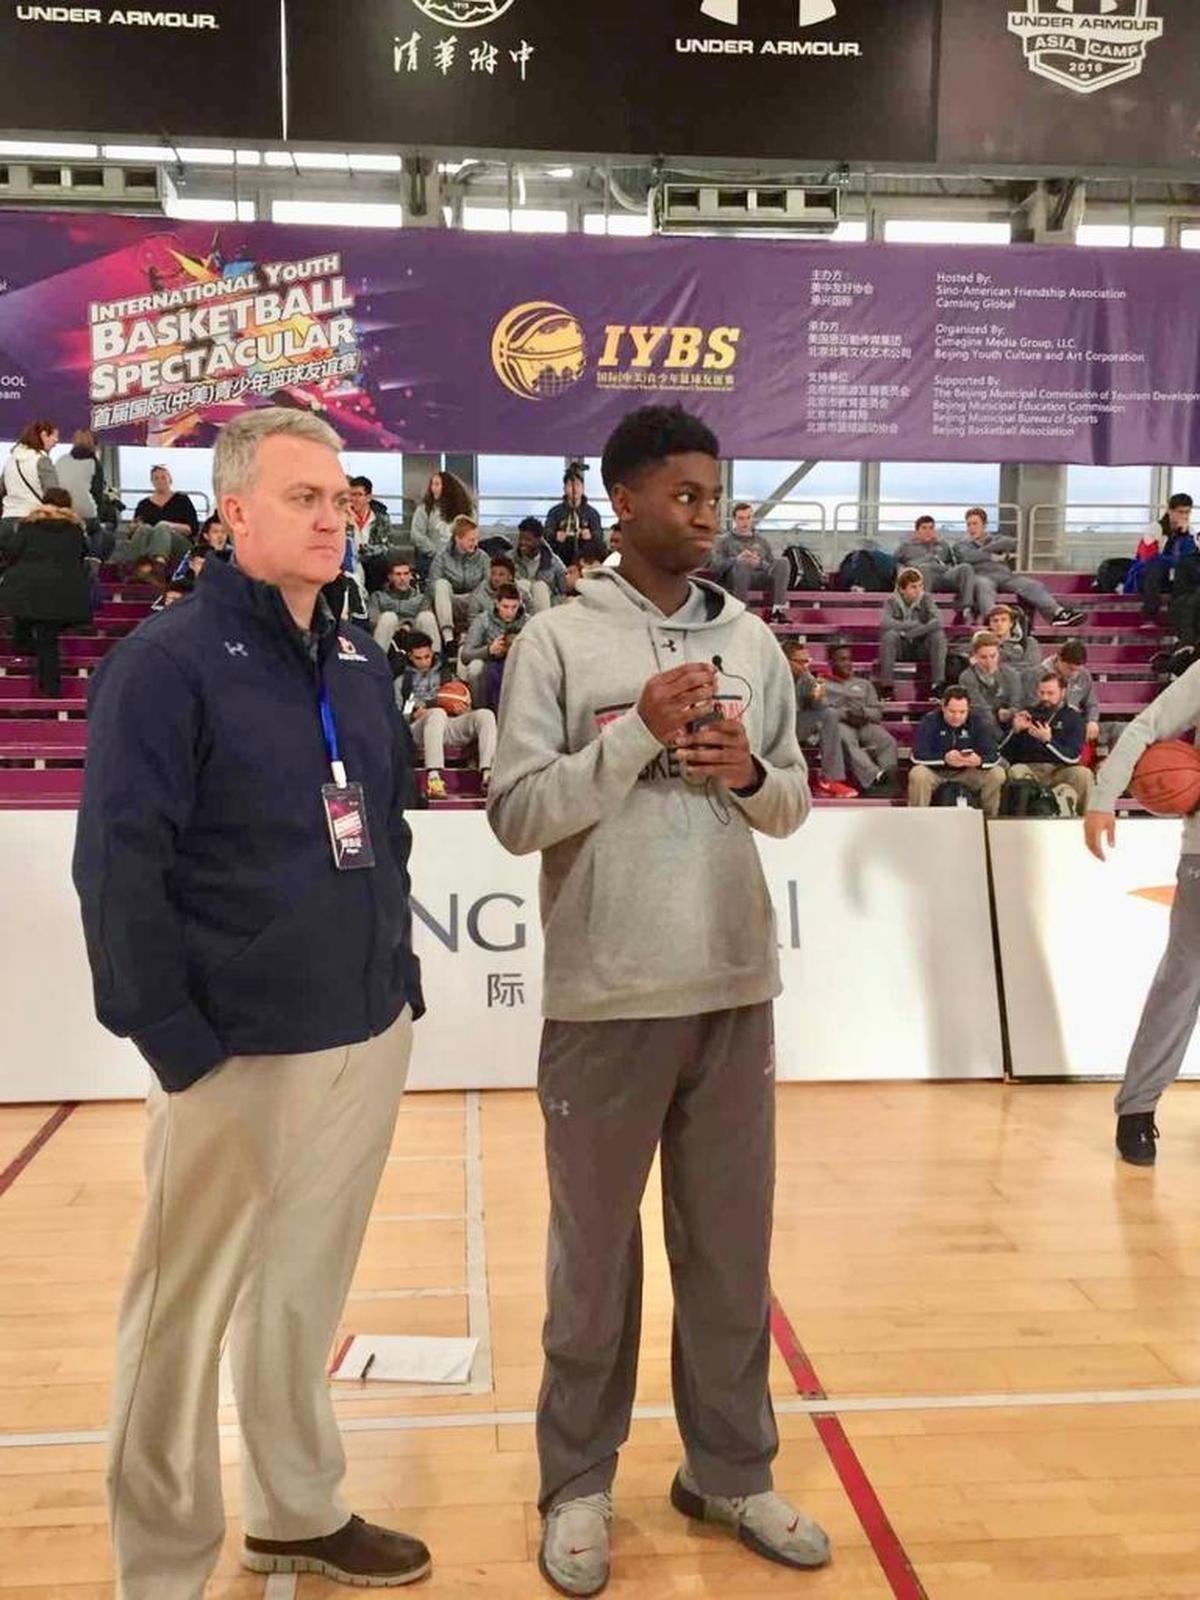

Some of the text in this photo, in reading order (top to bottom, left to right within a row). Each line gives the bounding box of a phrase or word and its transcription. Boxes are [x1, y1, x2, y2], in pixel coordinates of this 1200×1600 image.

[16, 6, 101, 23] UNDER
[1012, 15, 1158, 31] UNDER ARMOUR
[676, 39, 754, 54] UNDER
[1034, 35, 1139, 57] ASIA CAMP
[1068, 62, 1103, 73] 2016
[936, 272, 974, 283] Hosted
[91, 254, 339, 323] INTERNATIONAL YOUTH
[936, 286, 1126, 299] Sino-American Friendship Association
[936, 299, 1016, 311] Camsing Global
[92, 279, 353, 360] BASKETBALL
[936, 324, 988, 337] Organized
[598, 325, 741, 370] IYBS
[986, 338, 1017, 348] Media
[92, 319, 355, 398] SPECTACULAR
[934, 350, 1145, 363] Beijing Youth Culture and Art Corporation
[934, 376, 986, 387] Supported
[934, 388, 951, 398] The
[954, 388, 988, 400] Beijing
[989, 388, 1036, 400] Municipal
[1038, 389, 1098, 400] Commission
[1100, 390, 1110, 400] of
[933, 400, 1126, 414] Beijing Municipal Education Commission
[933, 412, 1098, 425] Beijing Municipal Bureau of Sports
[933, 424, 1074, 436] Beijing Basketball Association
